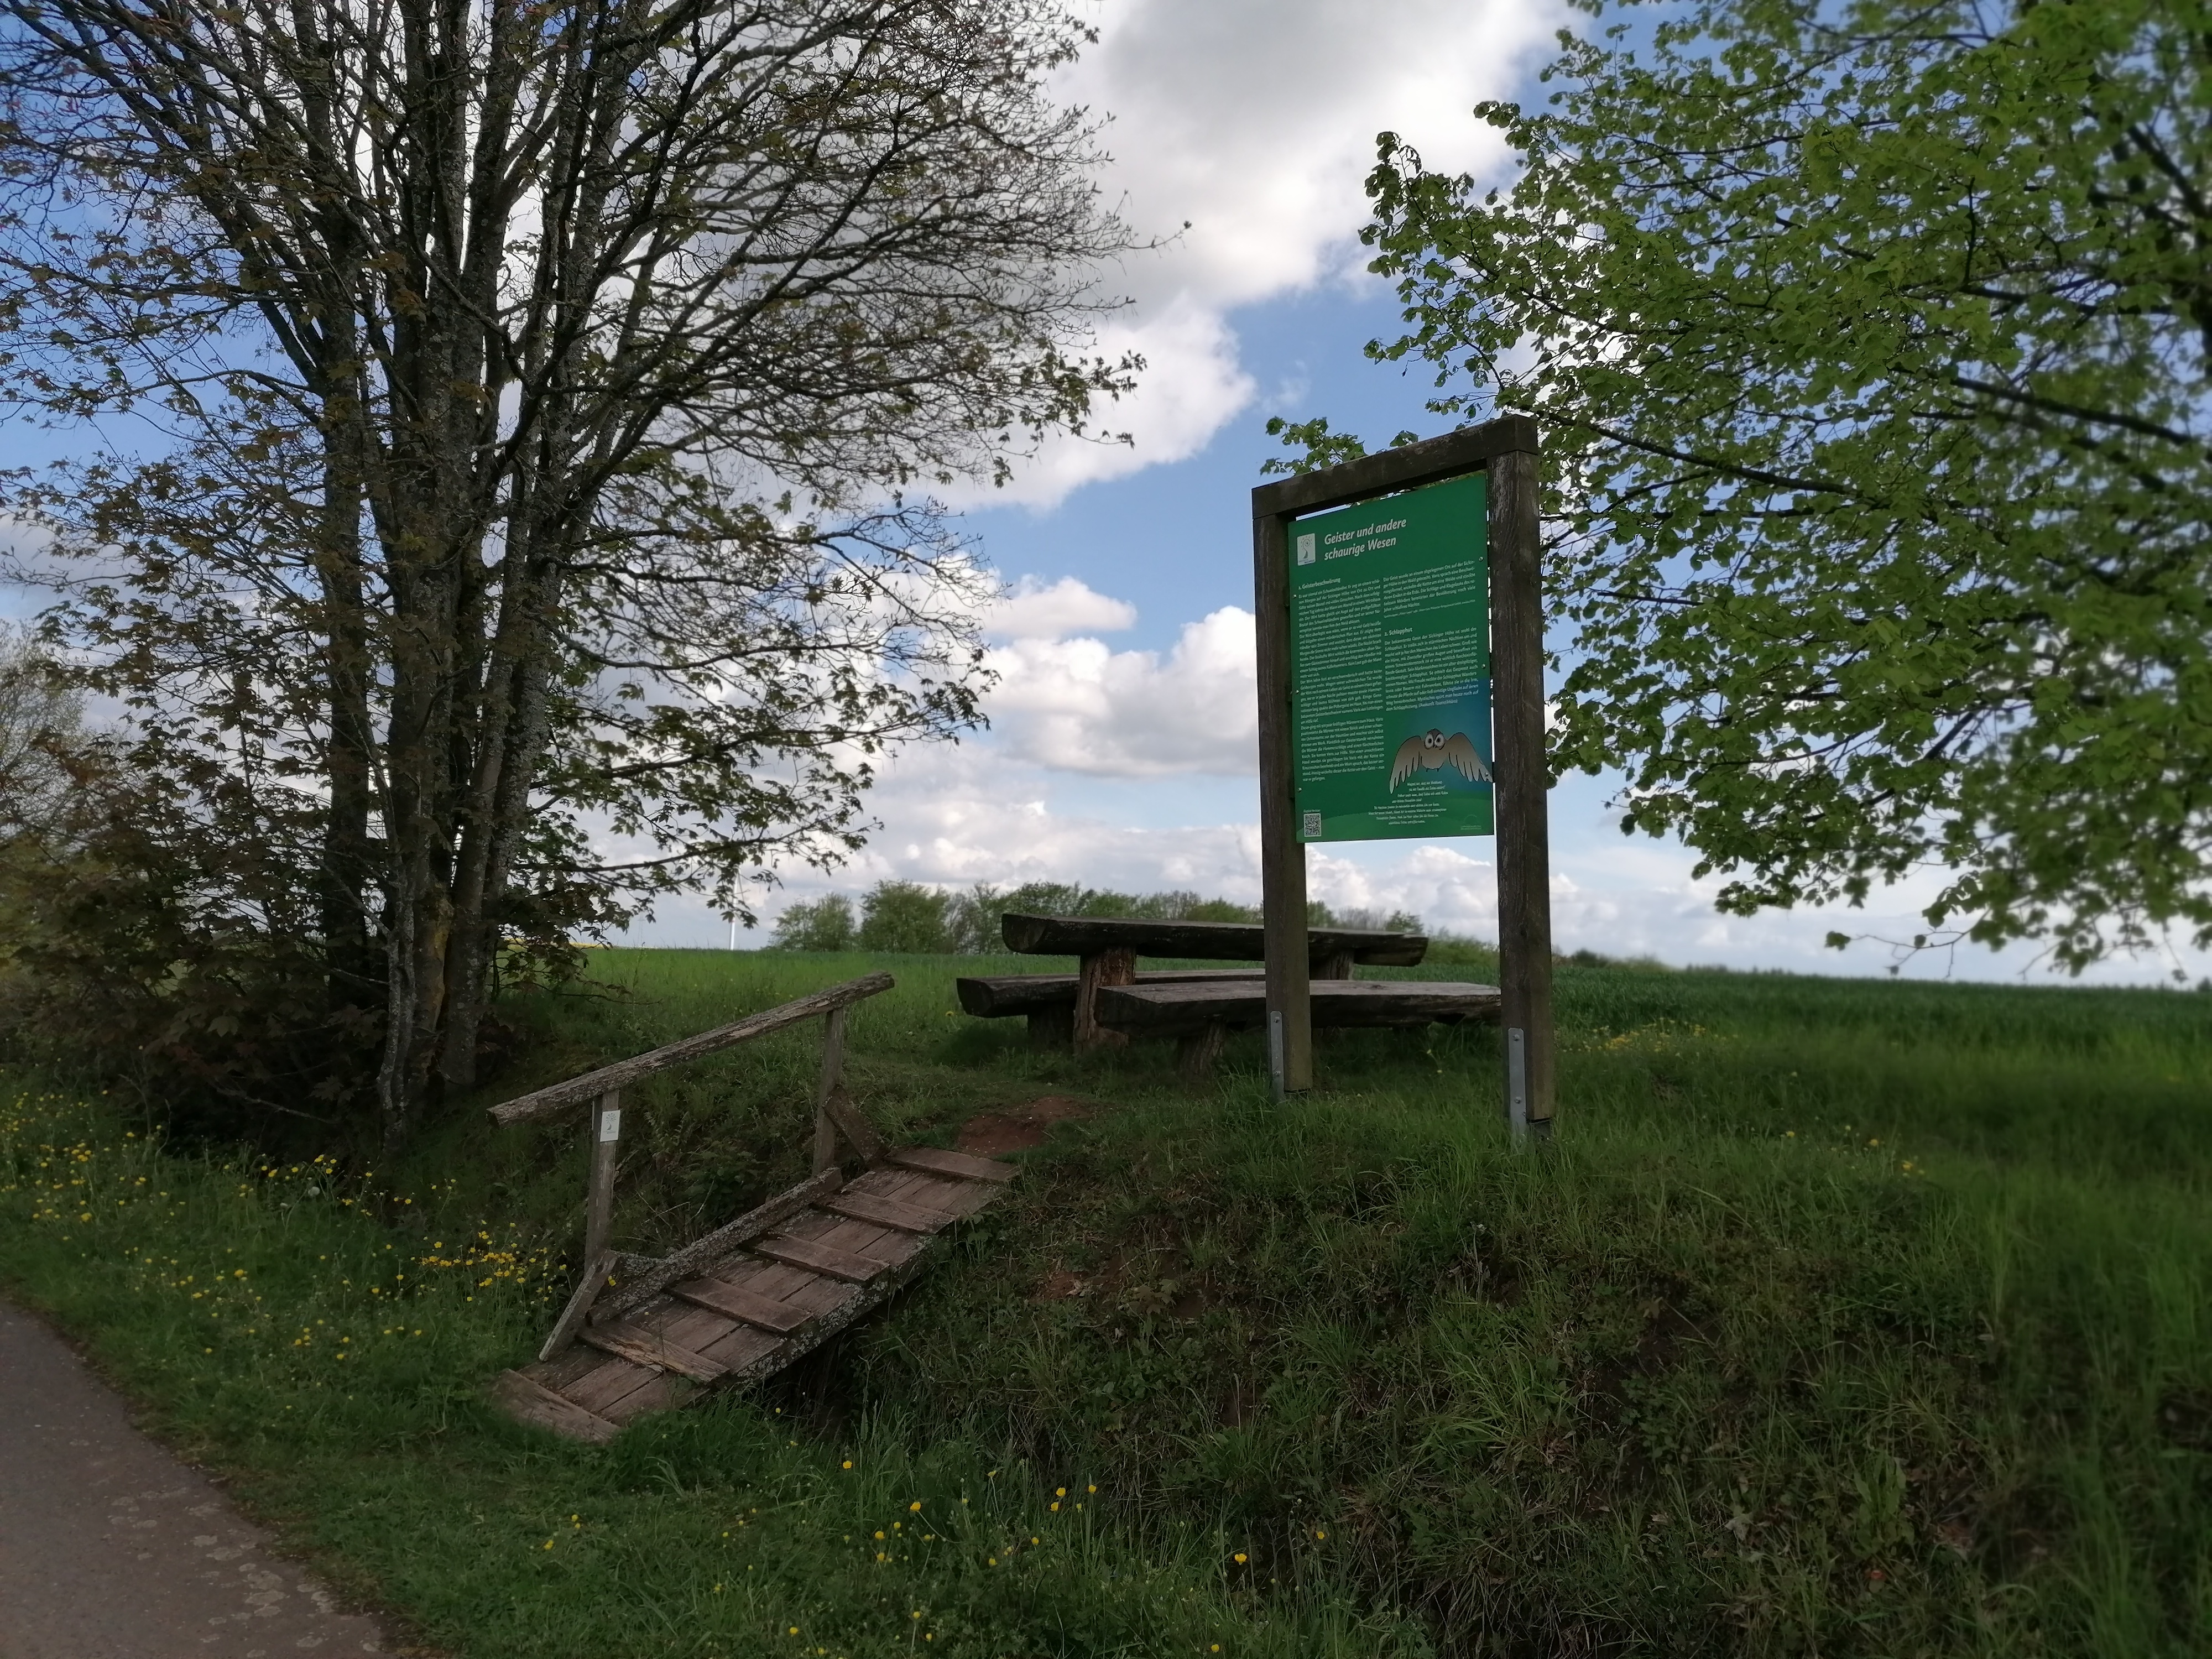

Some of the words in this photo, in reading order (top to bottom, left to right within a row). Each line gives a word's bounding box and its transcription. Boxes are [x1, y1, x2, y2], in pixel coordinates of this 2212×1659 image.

[1324, 531, 1355, 544] Geister
[1357, 523, 1374, 538] und
[1375, 519, 1406, 533] andere
[1324, 543, 1365, 560] schaurige
[1368, 538, 1396, 550] Wesen
[1389, 627, 1412, 635] Schlapphut
